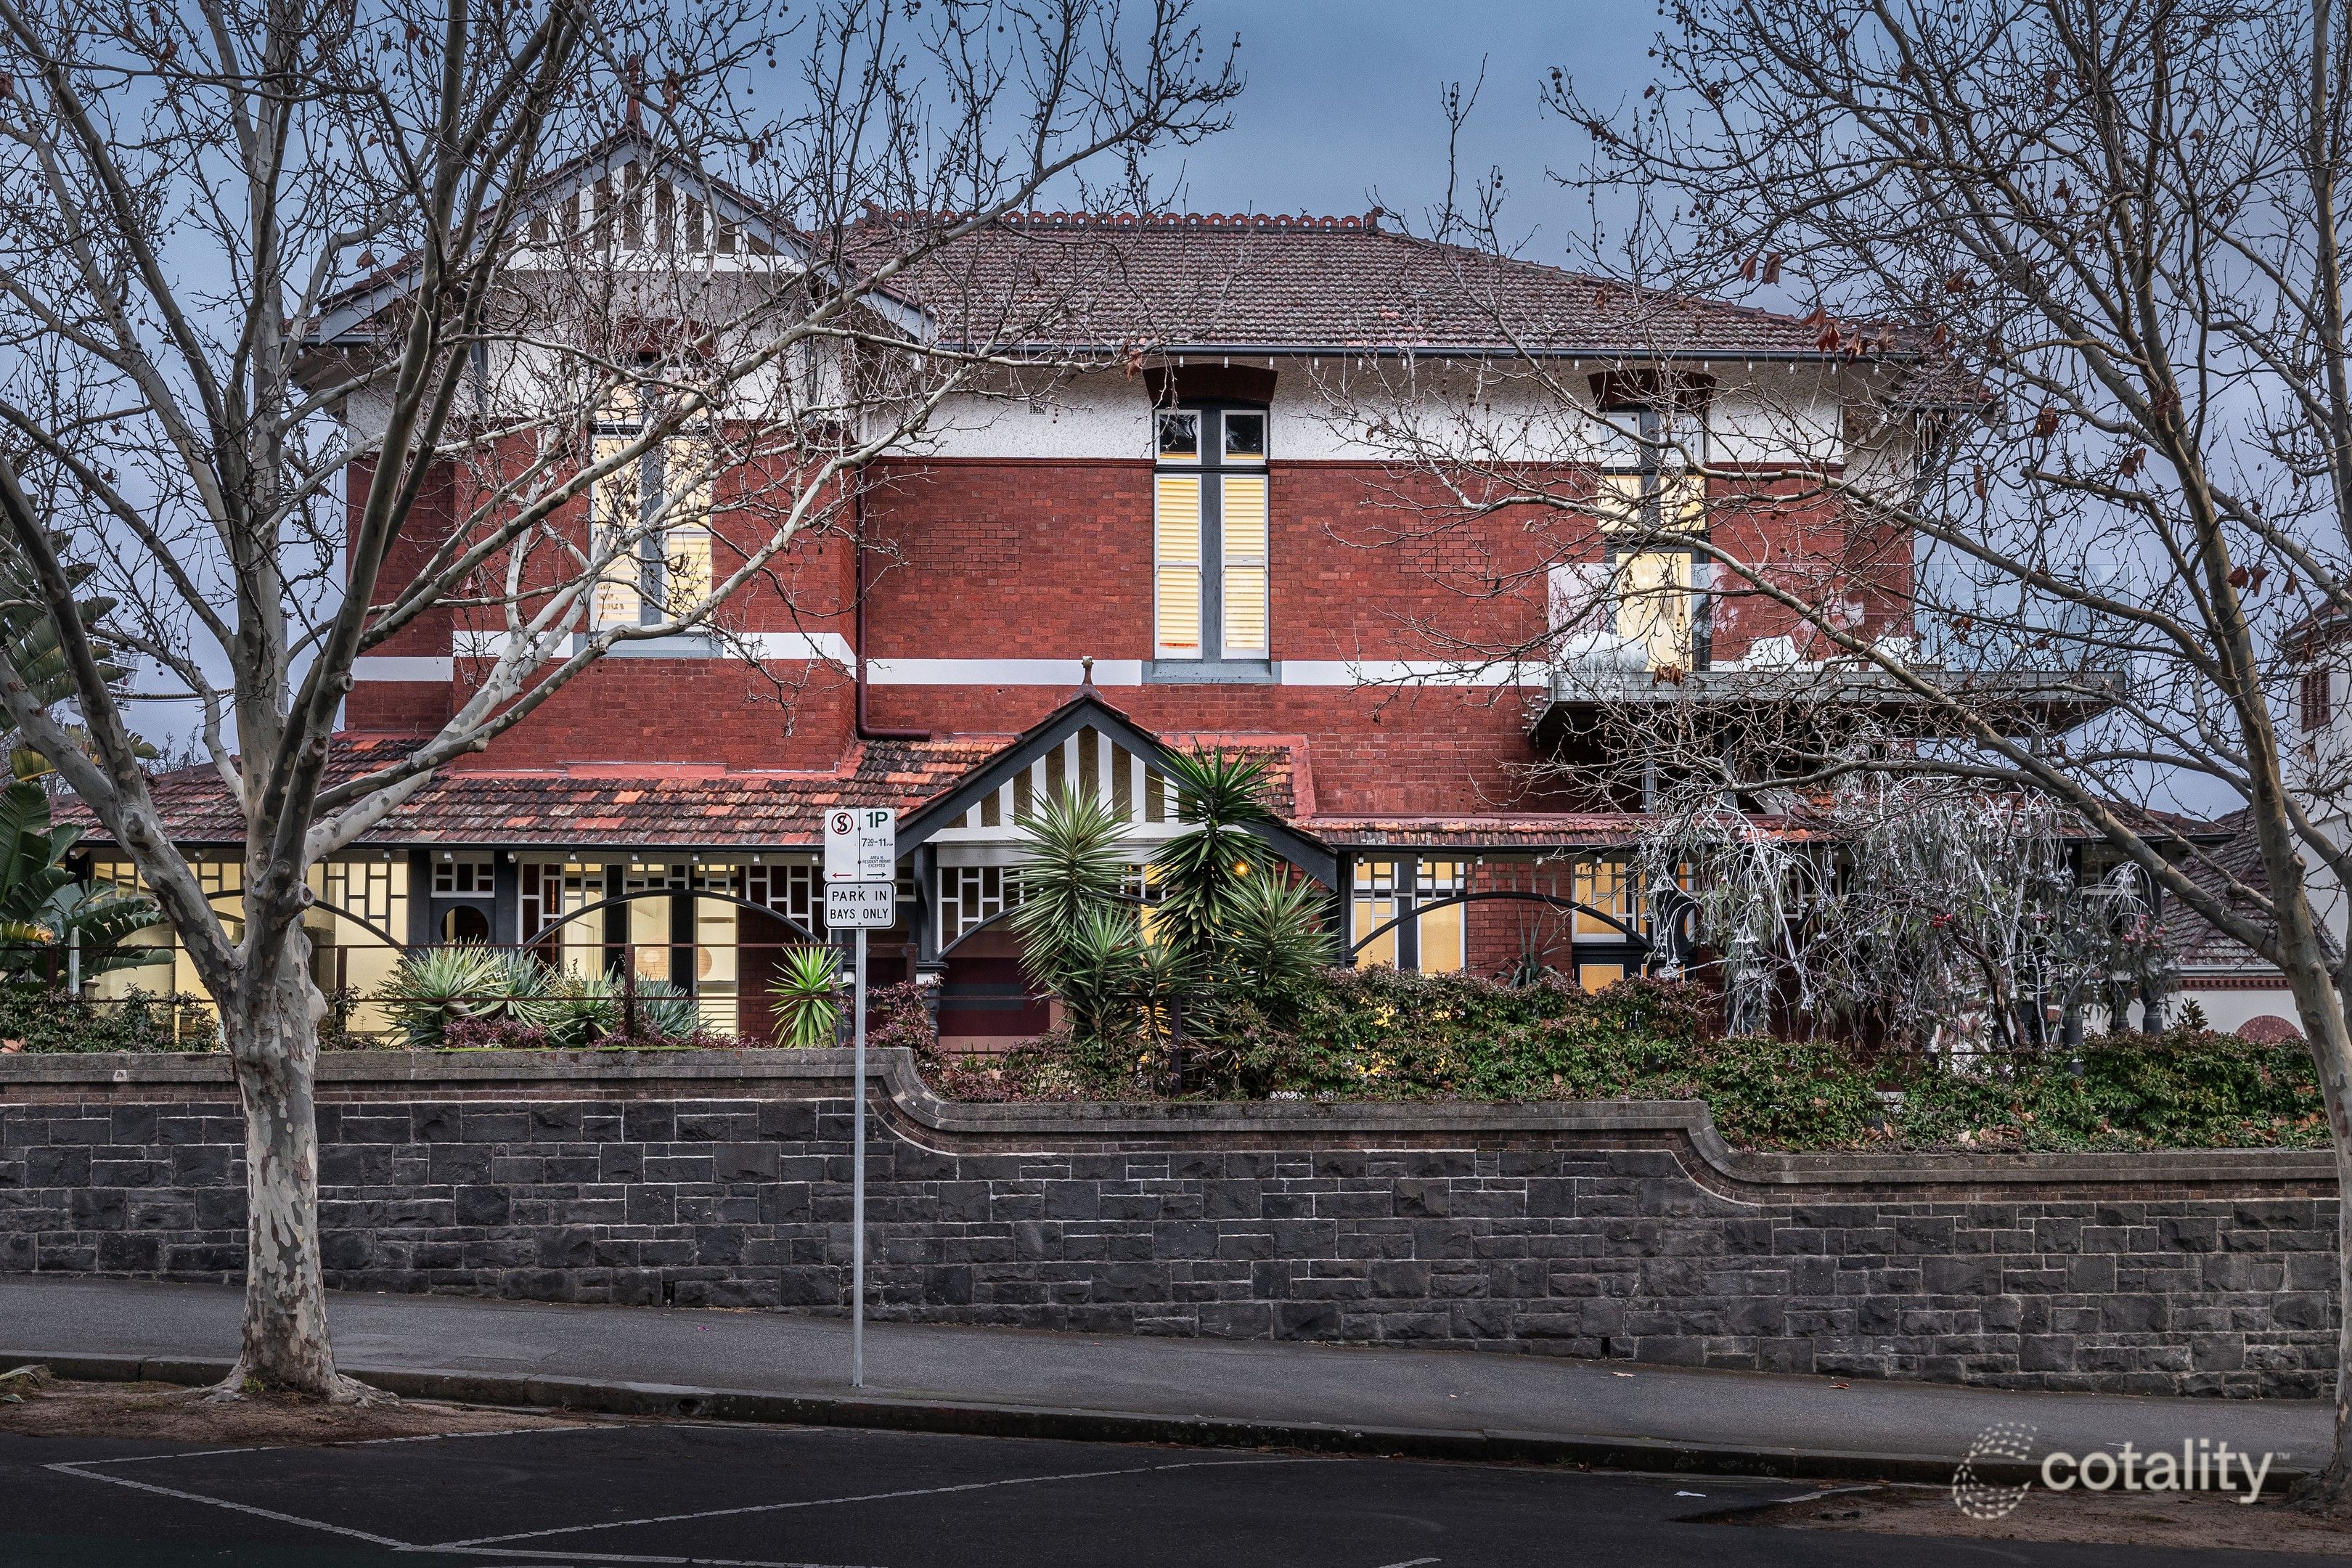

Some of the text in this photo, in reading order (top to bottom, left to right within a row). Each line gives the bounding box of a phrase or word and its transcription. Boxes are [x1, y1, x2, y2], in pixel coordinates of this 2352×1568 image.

[866, 812, 888, 828] 1P
[832, 890, 887, 902] PARK IN
[830, 908, 889, 920] BAYS ONLY
